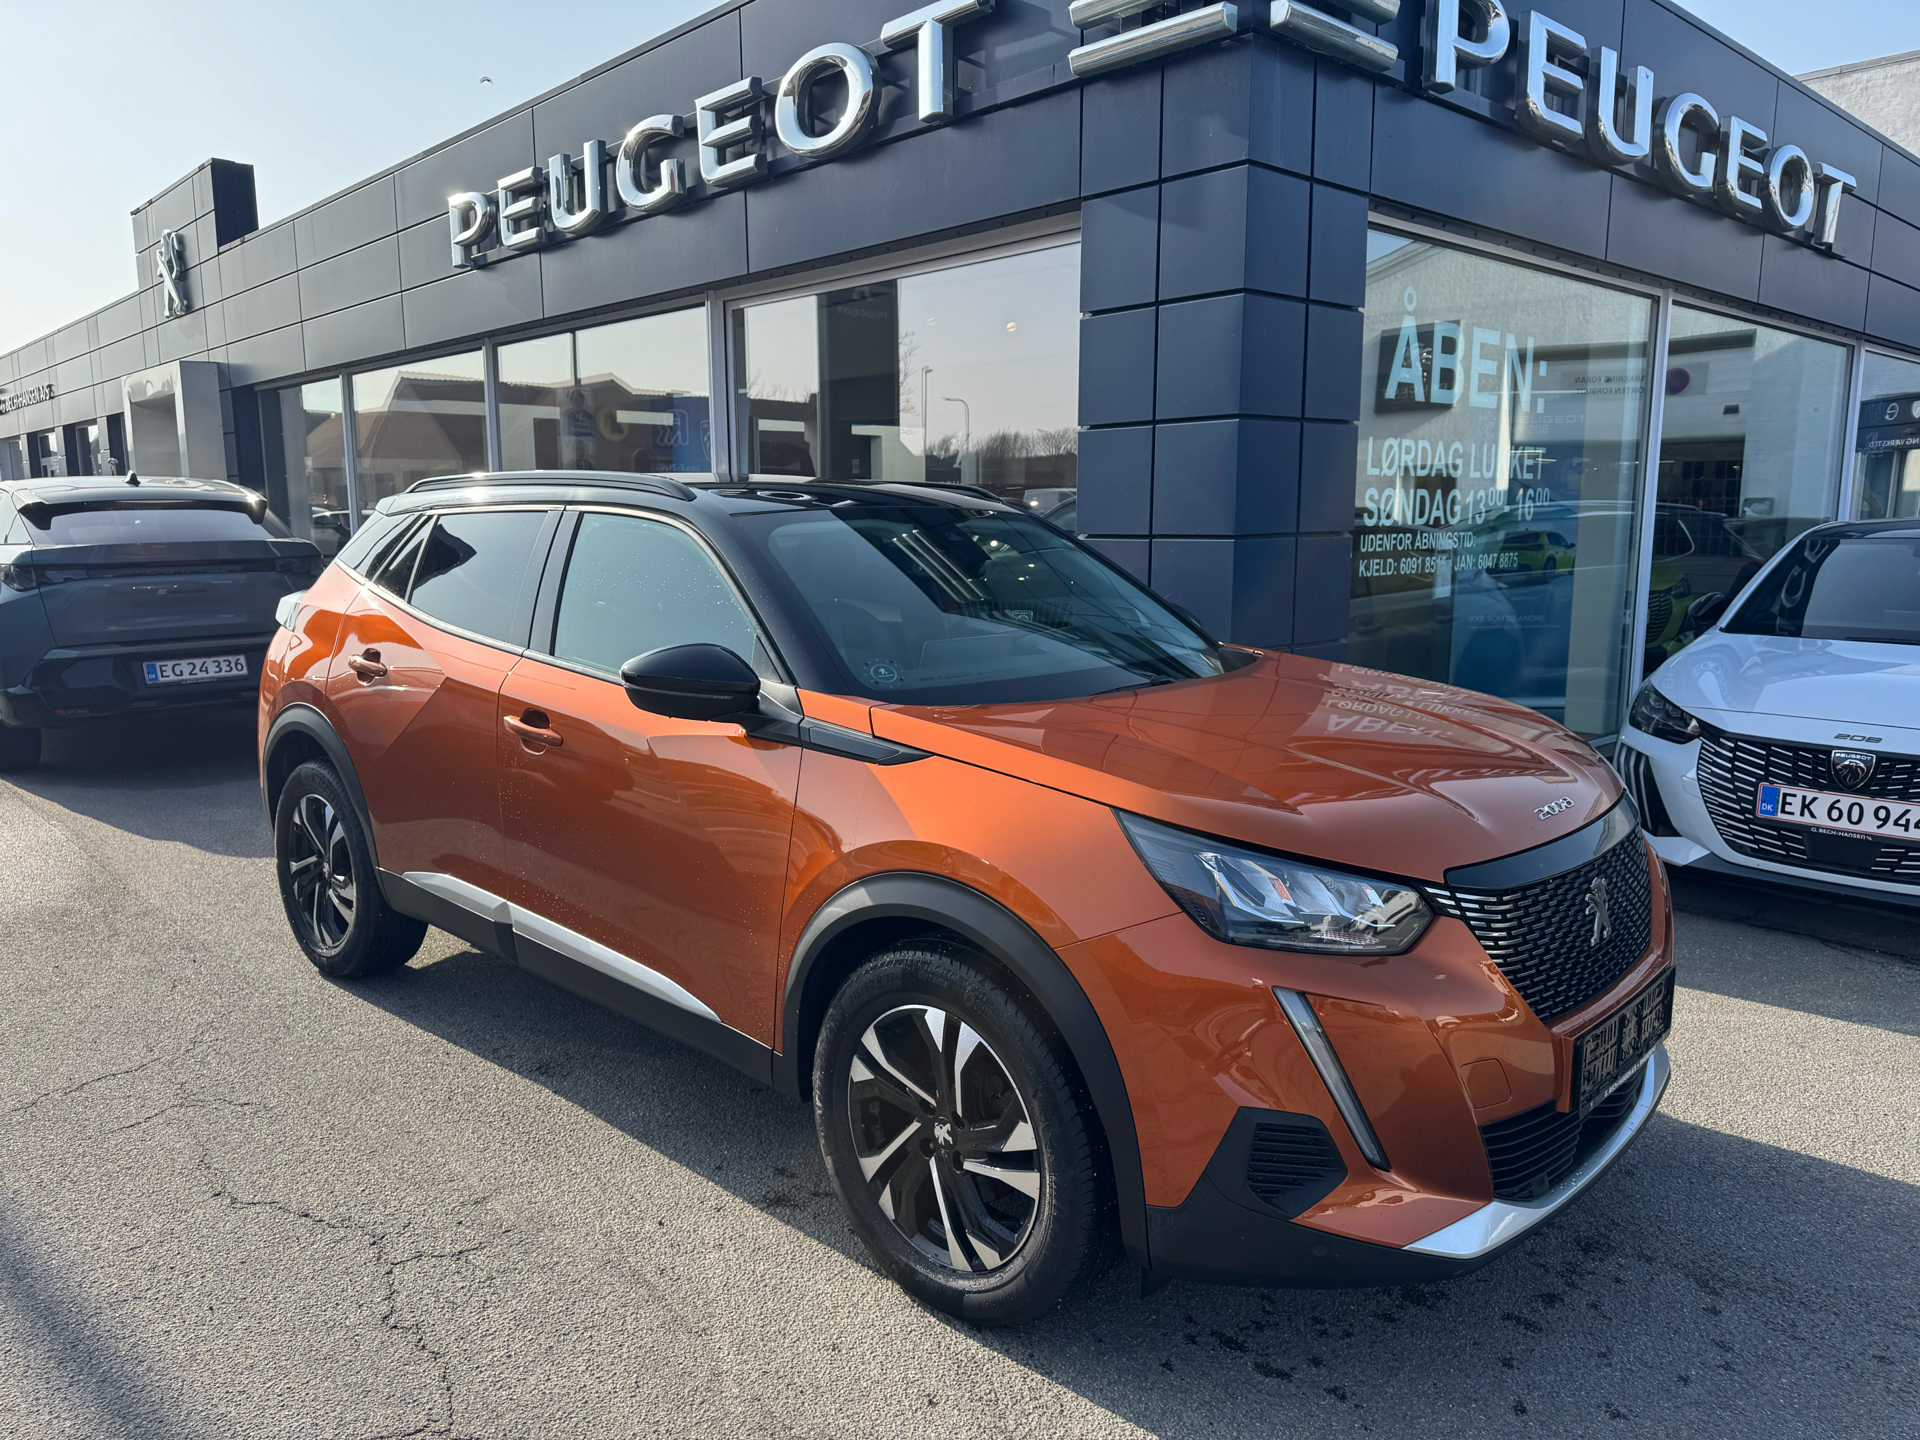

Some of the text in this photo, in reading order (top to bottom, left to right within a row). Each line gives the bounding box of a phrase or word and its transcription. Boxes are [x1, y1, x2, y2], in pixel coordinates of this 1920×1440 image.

[447, 0, 995, 268] PEUGEOT
[1422, 0, 1857, 248] PEUGEOT
[1512, 414, 1585, 424] EUGEOT
[1366, 436, 1464, 478] LØRDAG
[1363, 487, 1462, 528] SØNDAG
[1360, 533, 1412, 552] UDENFOR
[1358, 557, 1397, 578] KJELD:
[1400, 556, 1422, 575] 6091
[1454, 554, 1476, 572] JAN:
[1478, 552, 1496, 569] 6047
[1499, 552, 1519, 568] 8875
[158, 657, 244, 679] EG 24 336
[1833, 732, 1883, 744] 208
[1835, 752, 1872, 761] PEUGEOT
[1533, 796, 1575, 820] 2008
[1761, 803, 1773, 812] DK
[1780, 792, 1820, 820] EK
[1827, 799, 1864, 826] 60
